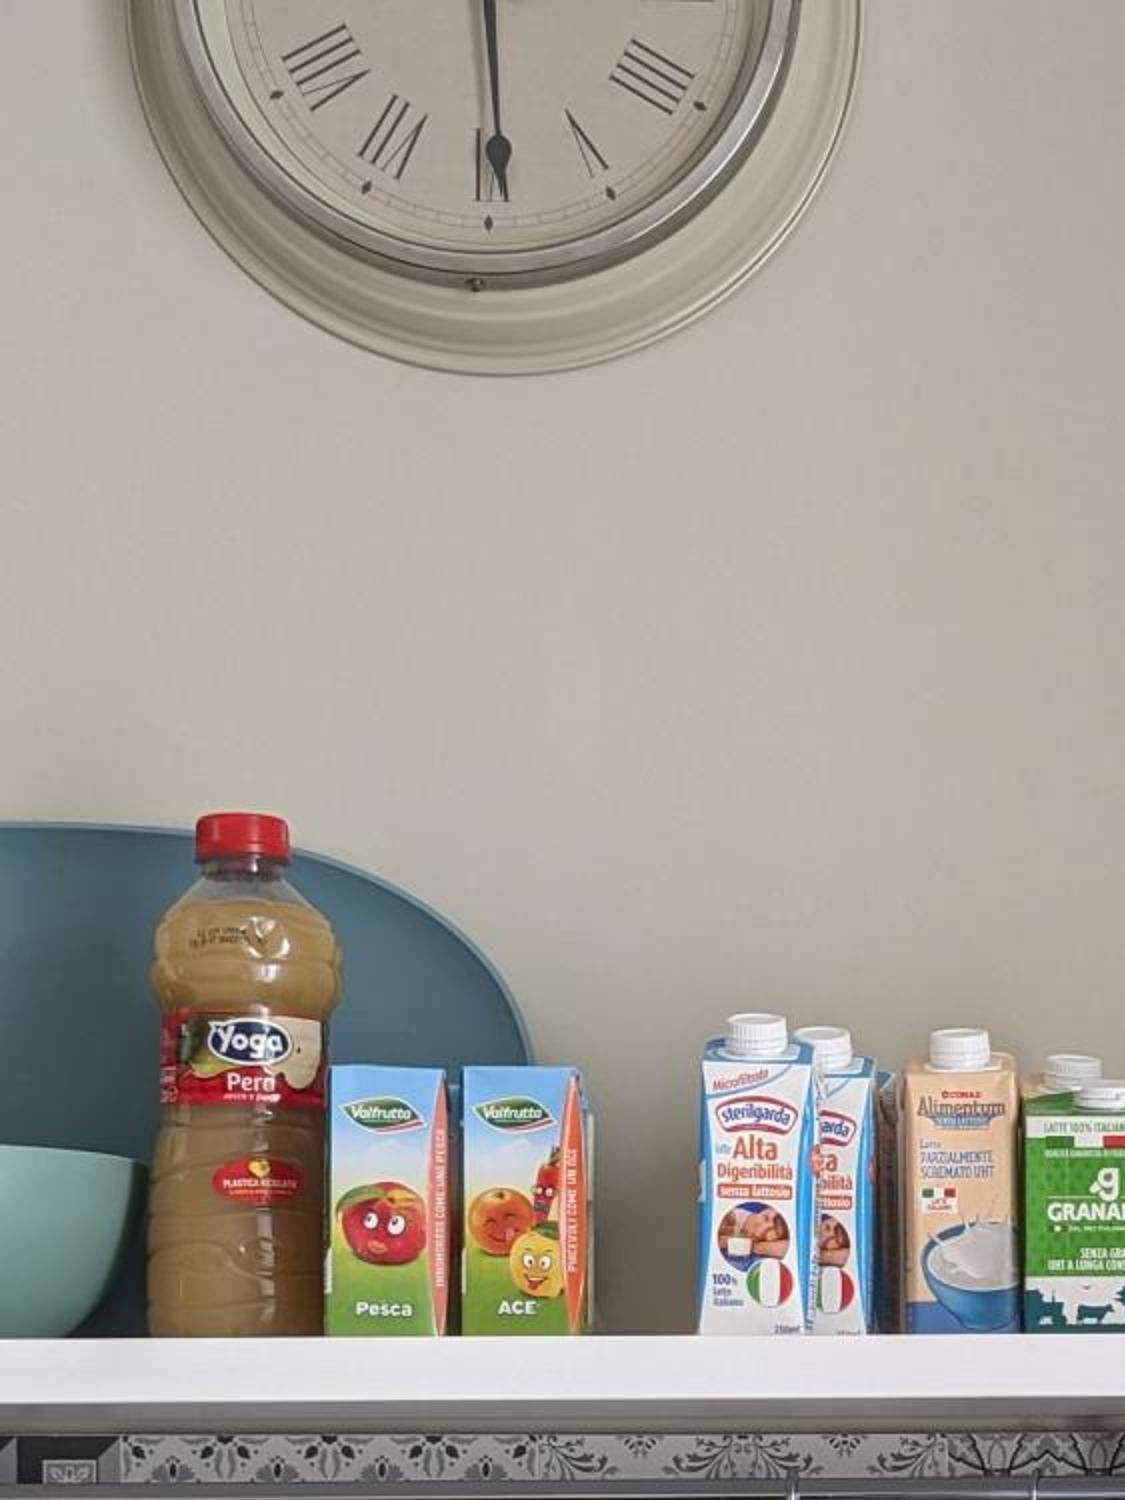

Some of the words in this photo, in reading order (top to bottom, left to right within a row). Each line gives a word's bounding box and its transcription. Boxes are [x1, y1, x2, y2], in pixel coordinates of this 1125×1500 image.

[218, 1025, 284, 1059] Yoga
[227, 1072, 277, 1092] Pera
[351, 1104, 411, 1120] Valfrutto
[483, 1104, 542, 1119] Valfrutto
[917, 1096, 1006, 1117] Alimentum
[733, 1134, 778, 1161] Alta
[355, 1301, 413, 1316] Pesca
[498, 1301, 537, 1315] ACE
